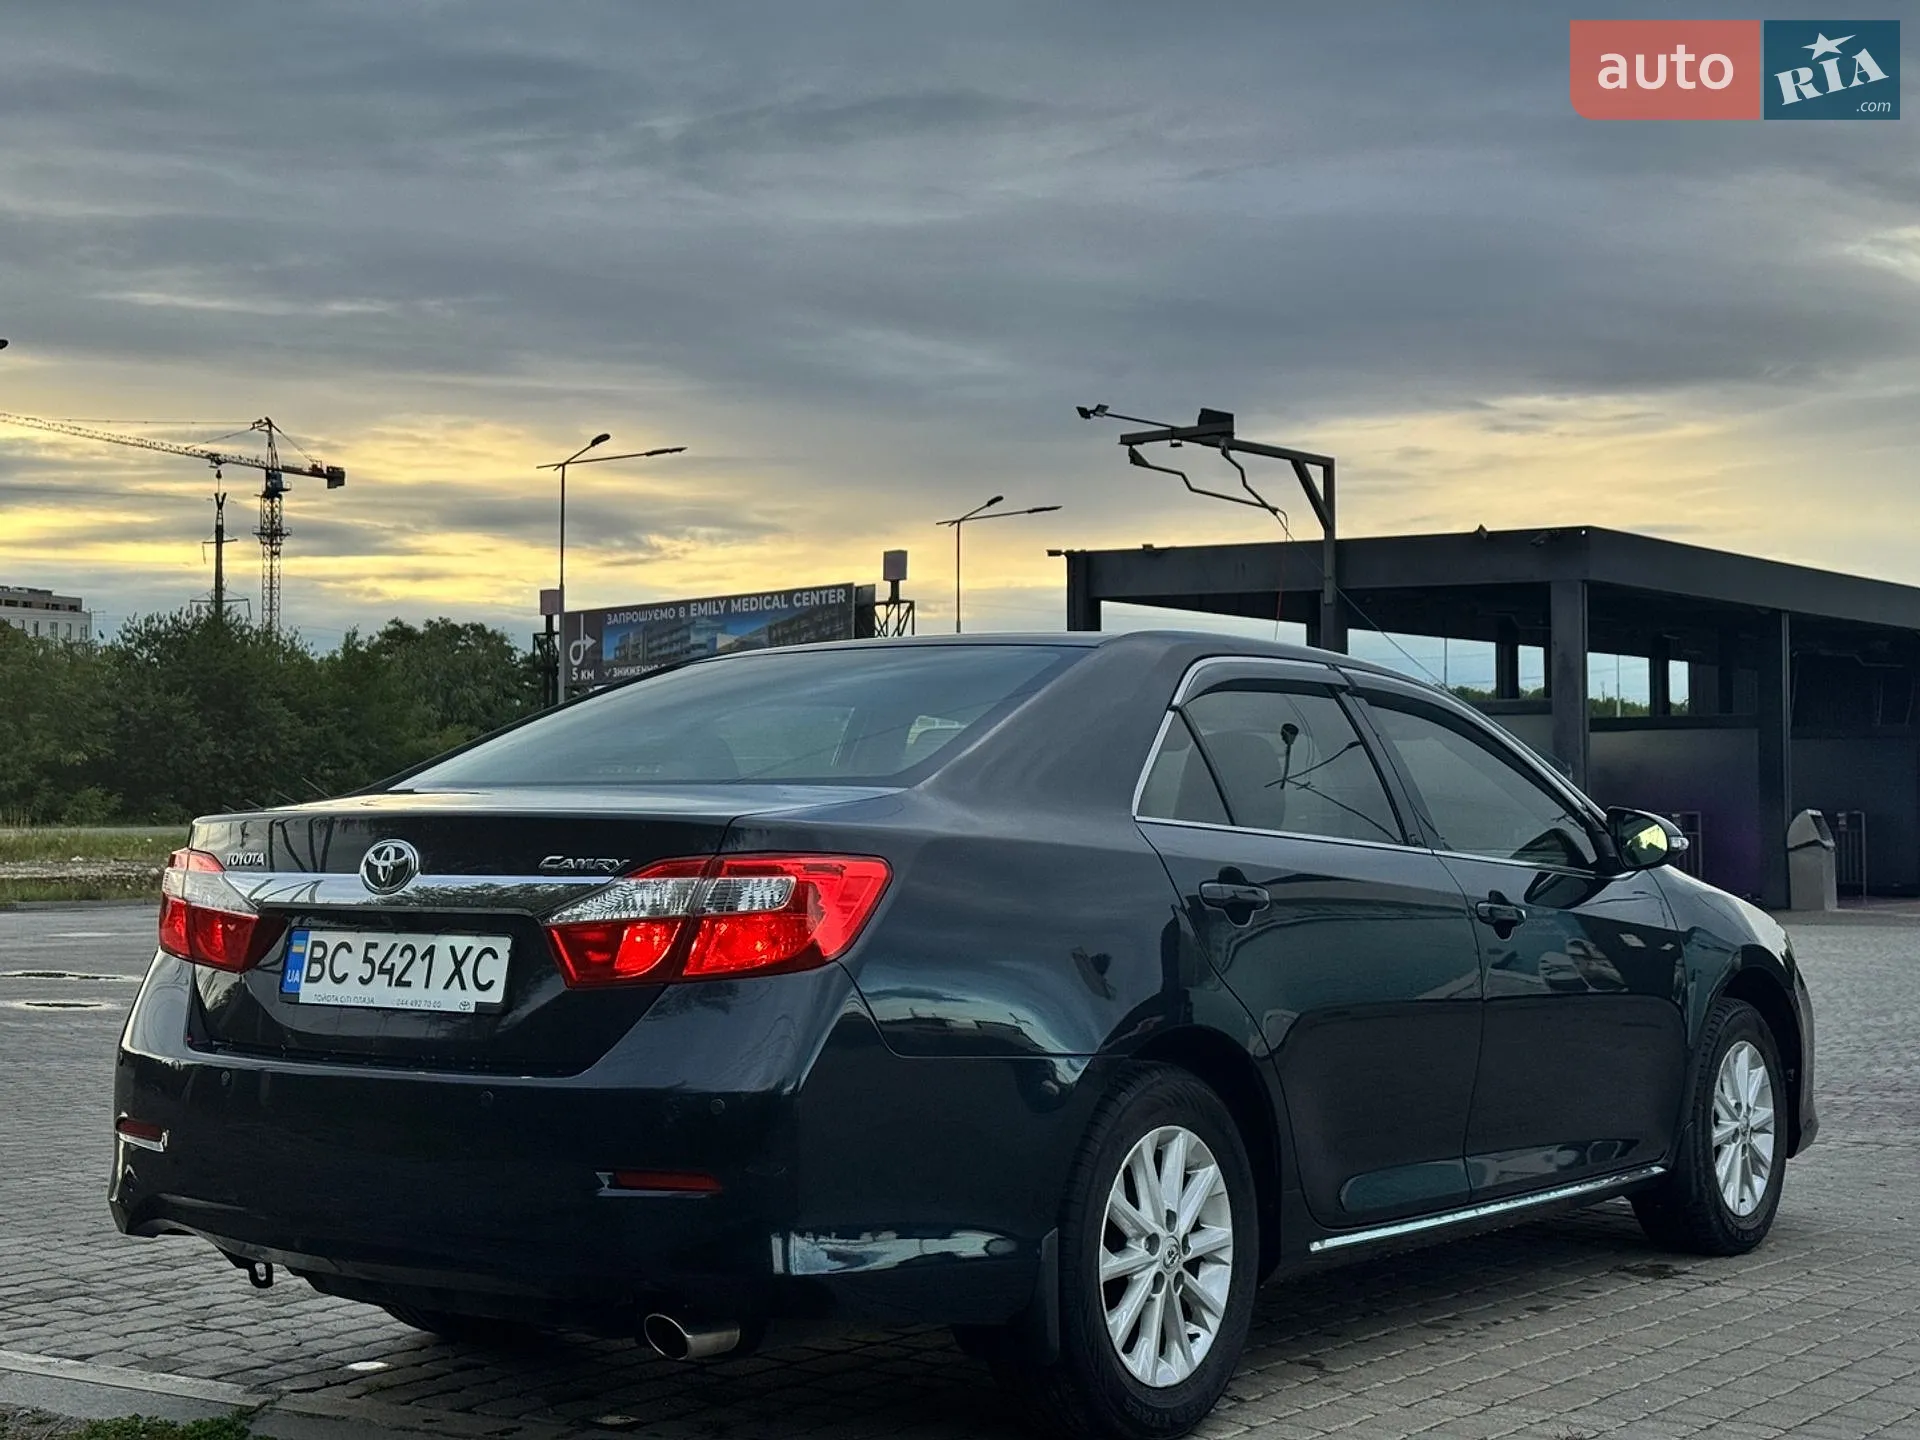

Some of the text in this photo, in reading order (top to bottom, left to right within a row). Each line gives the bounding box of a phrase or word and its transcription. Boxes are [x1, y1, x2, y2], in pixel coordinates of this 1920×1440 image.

[607, 608, 676, 625] ЗАПРОШУЄМО
[690, 600, 727, 618] EMILY
[731, 594, 789, 613] MEDICAL
[793, 588, 846, 608] CENTER
[571, 667, 578, 681] 5
[225, 852, 265, 867] TOYOTA
[305, 940, 499, 992] BC 5421 XC
[287, 969, 300, 983] UA
